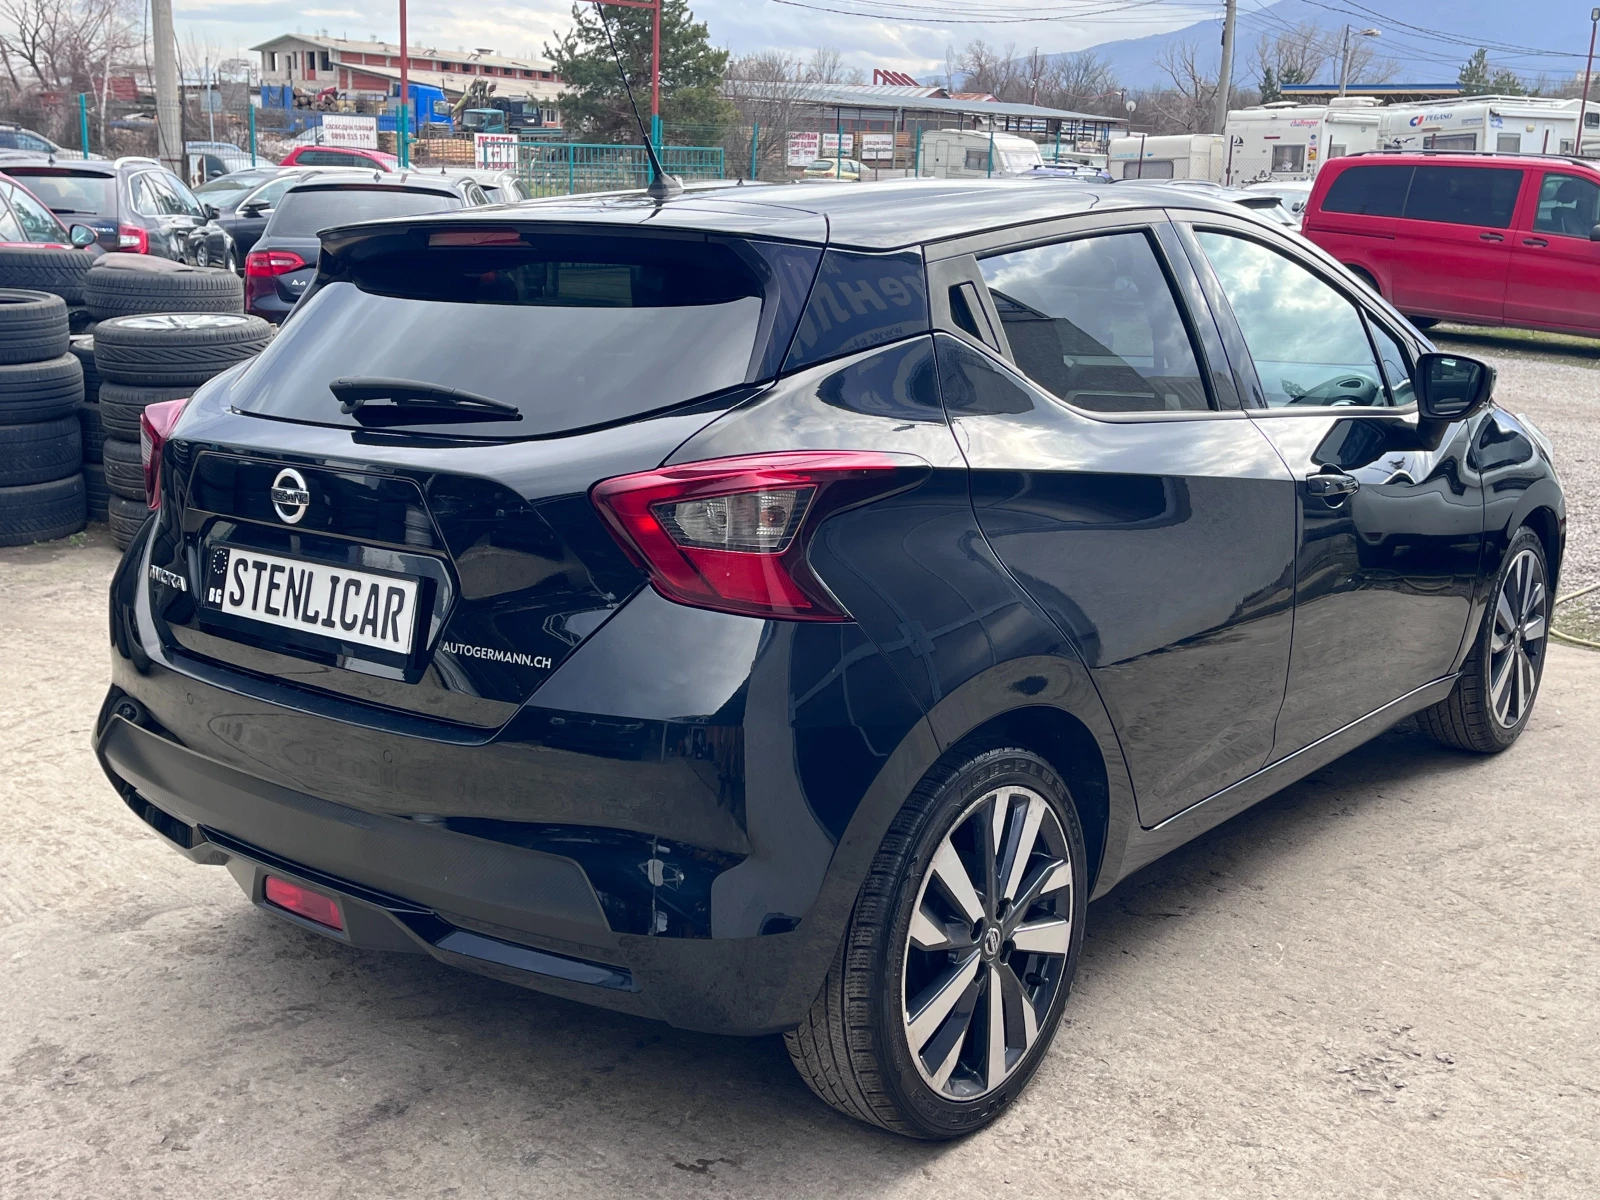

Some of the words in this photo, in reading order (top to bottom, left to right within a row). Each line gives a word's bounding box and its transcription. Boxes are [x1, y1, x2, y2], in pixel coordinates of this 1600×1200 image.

[1425, 113, 1453, 121] PEGASO
[149, 565, 187, 592] MICRA
[209, 587, 222, 604] BG
[229, 557, 406, 642] STENLICAR
[442, 641, 552, 669] AUTOGERMANN.CH
